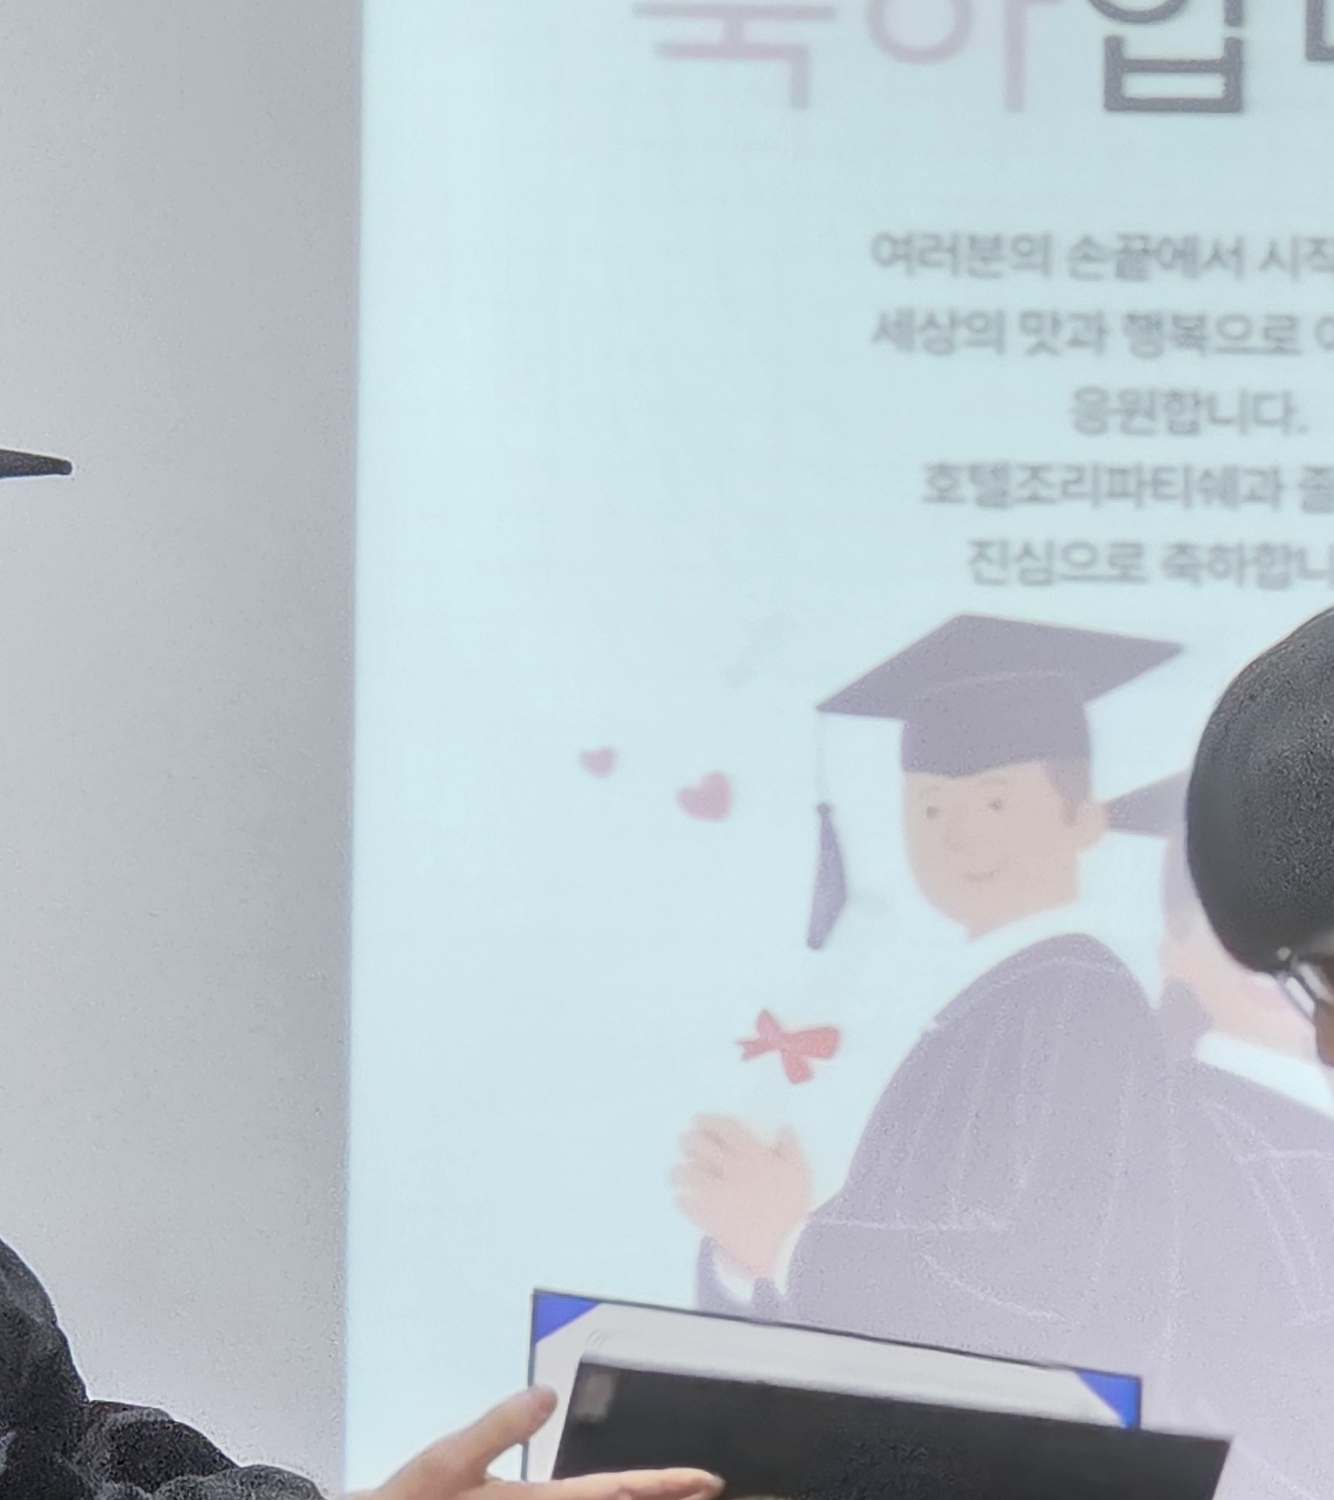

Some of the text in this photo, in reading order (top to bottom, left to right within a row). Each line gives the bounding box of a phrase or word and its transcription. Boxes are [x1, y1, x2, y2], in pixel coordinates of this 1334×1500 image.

[870, 230, 1054, 278] 여러분의
[1065, 233, 1245, 281] 손끝에서
[870, 308, 1007, 356] 세상의
[1018, 309, 1109, 358] 맛과
[1122, 311, 1305, 361] 행복으로
[1070, 386, 1309, 437] 응원합니다.
[967, 537, 1149, 588] 진심으로
